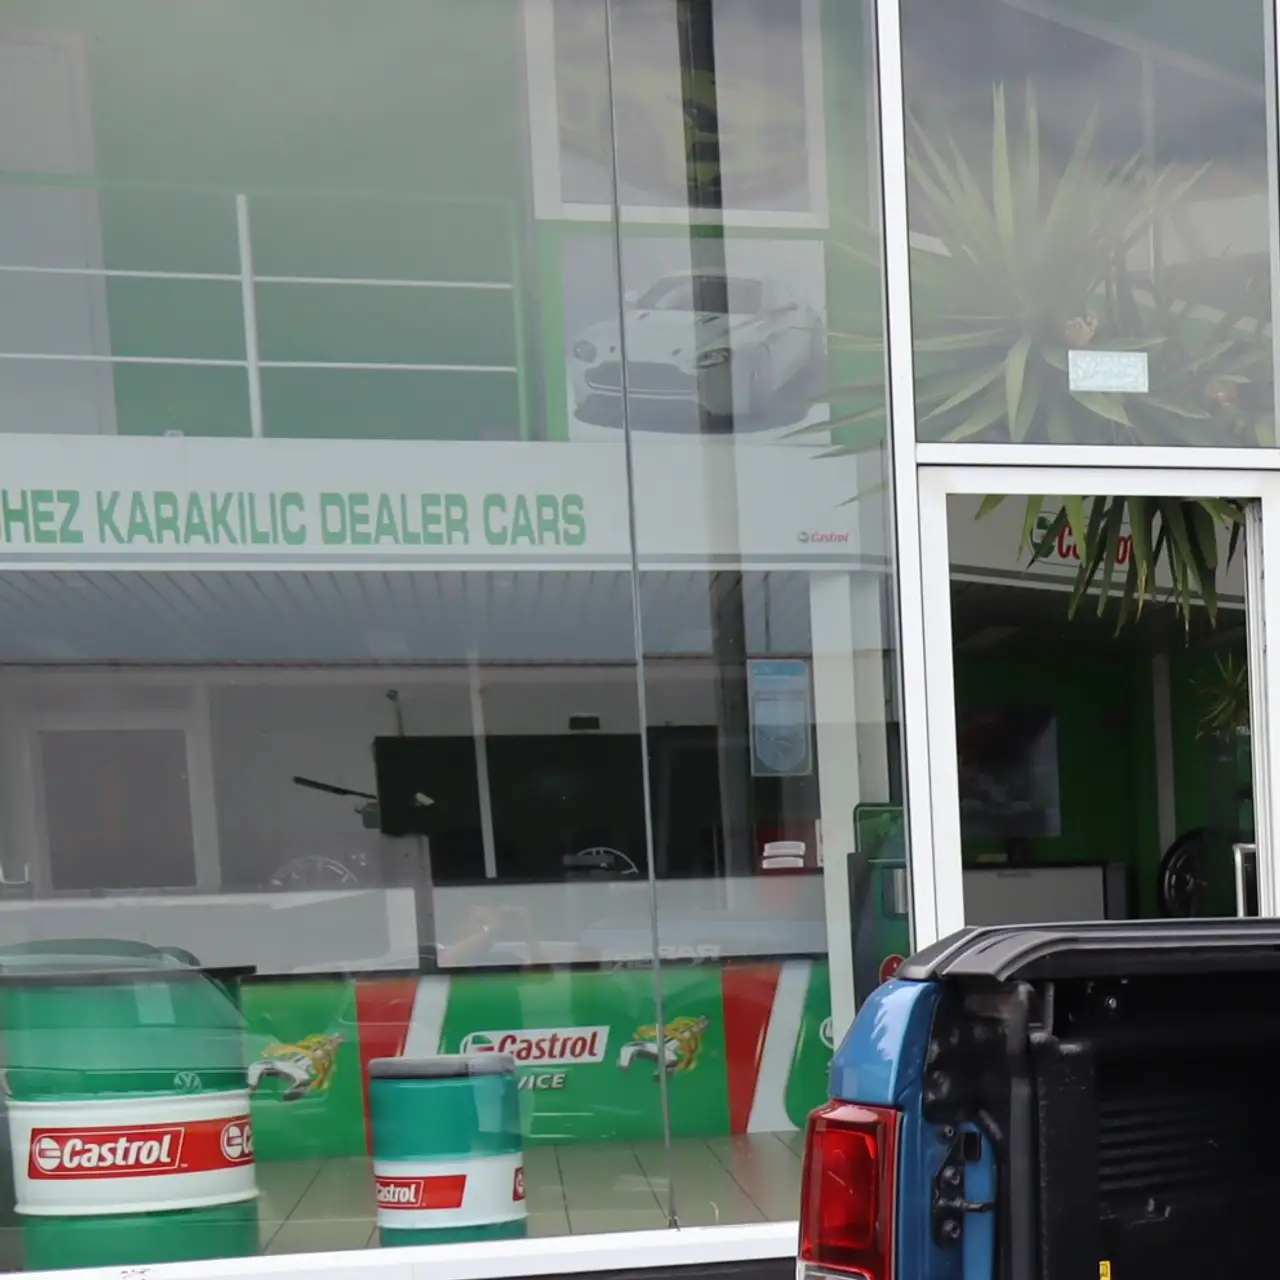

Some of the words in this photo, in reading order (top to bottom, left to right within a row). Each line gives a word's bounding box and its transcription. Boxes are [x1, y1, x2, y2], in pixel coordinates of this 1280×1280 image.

[0, 489, 83, 543] HEZ
[96, 490, 307, 546] KARAKILIC
[319, 492, 470, 546] DEALER
[482, 493, 586, 546] CARS
[498, 1031, 598, 1060] Castrol
[63, 1134, 172, 1168] Castrol
